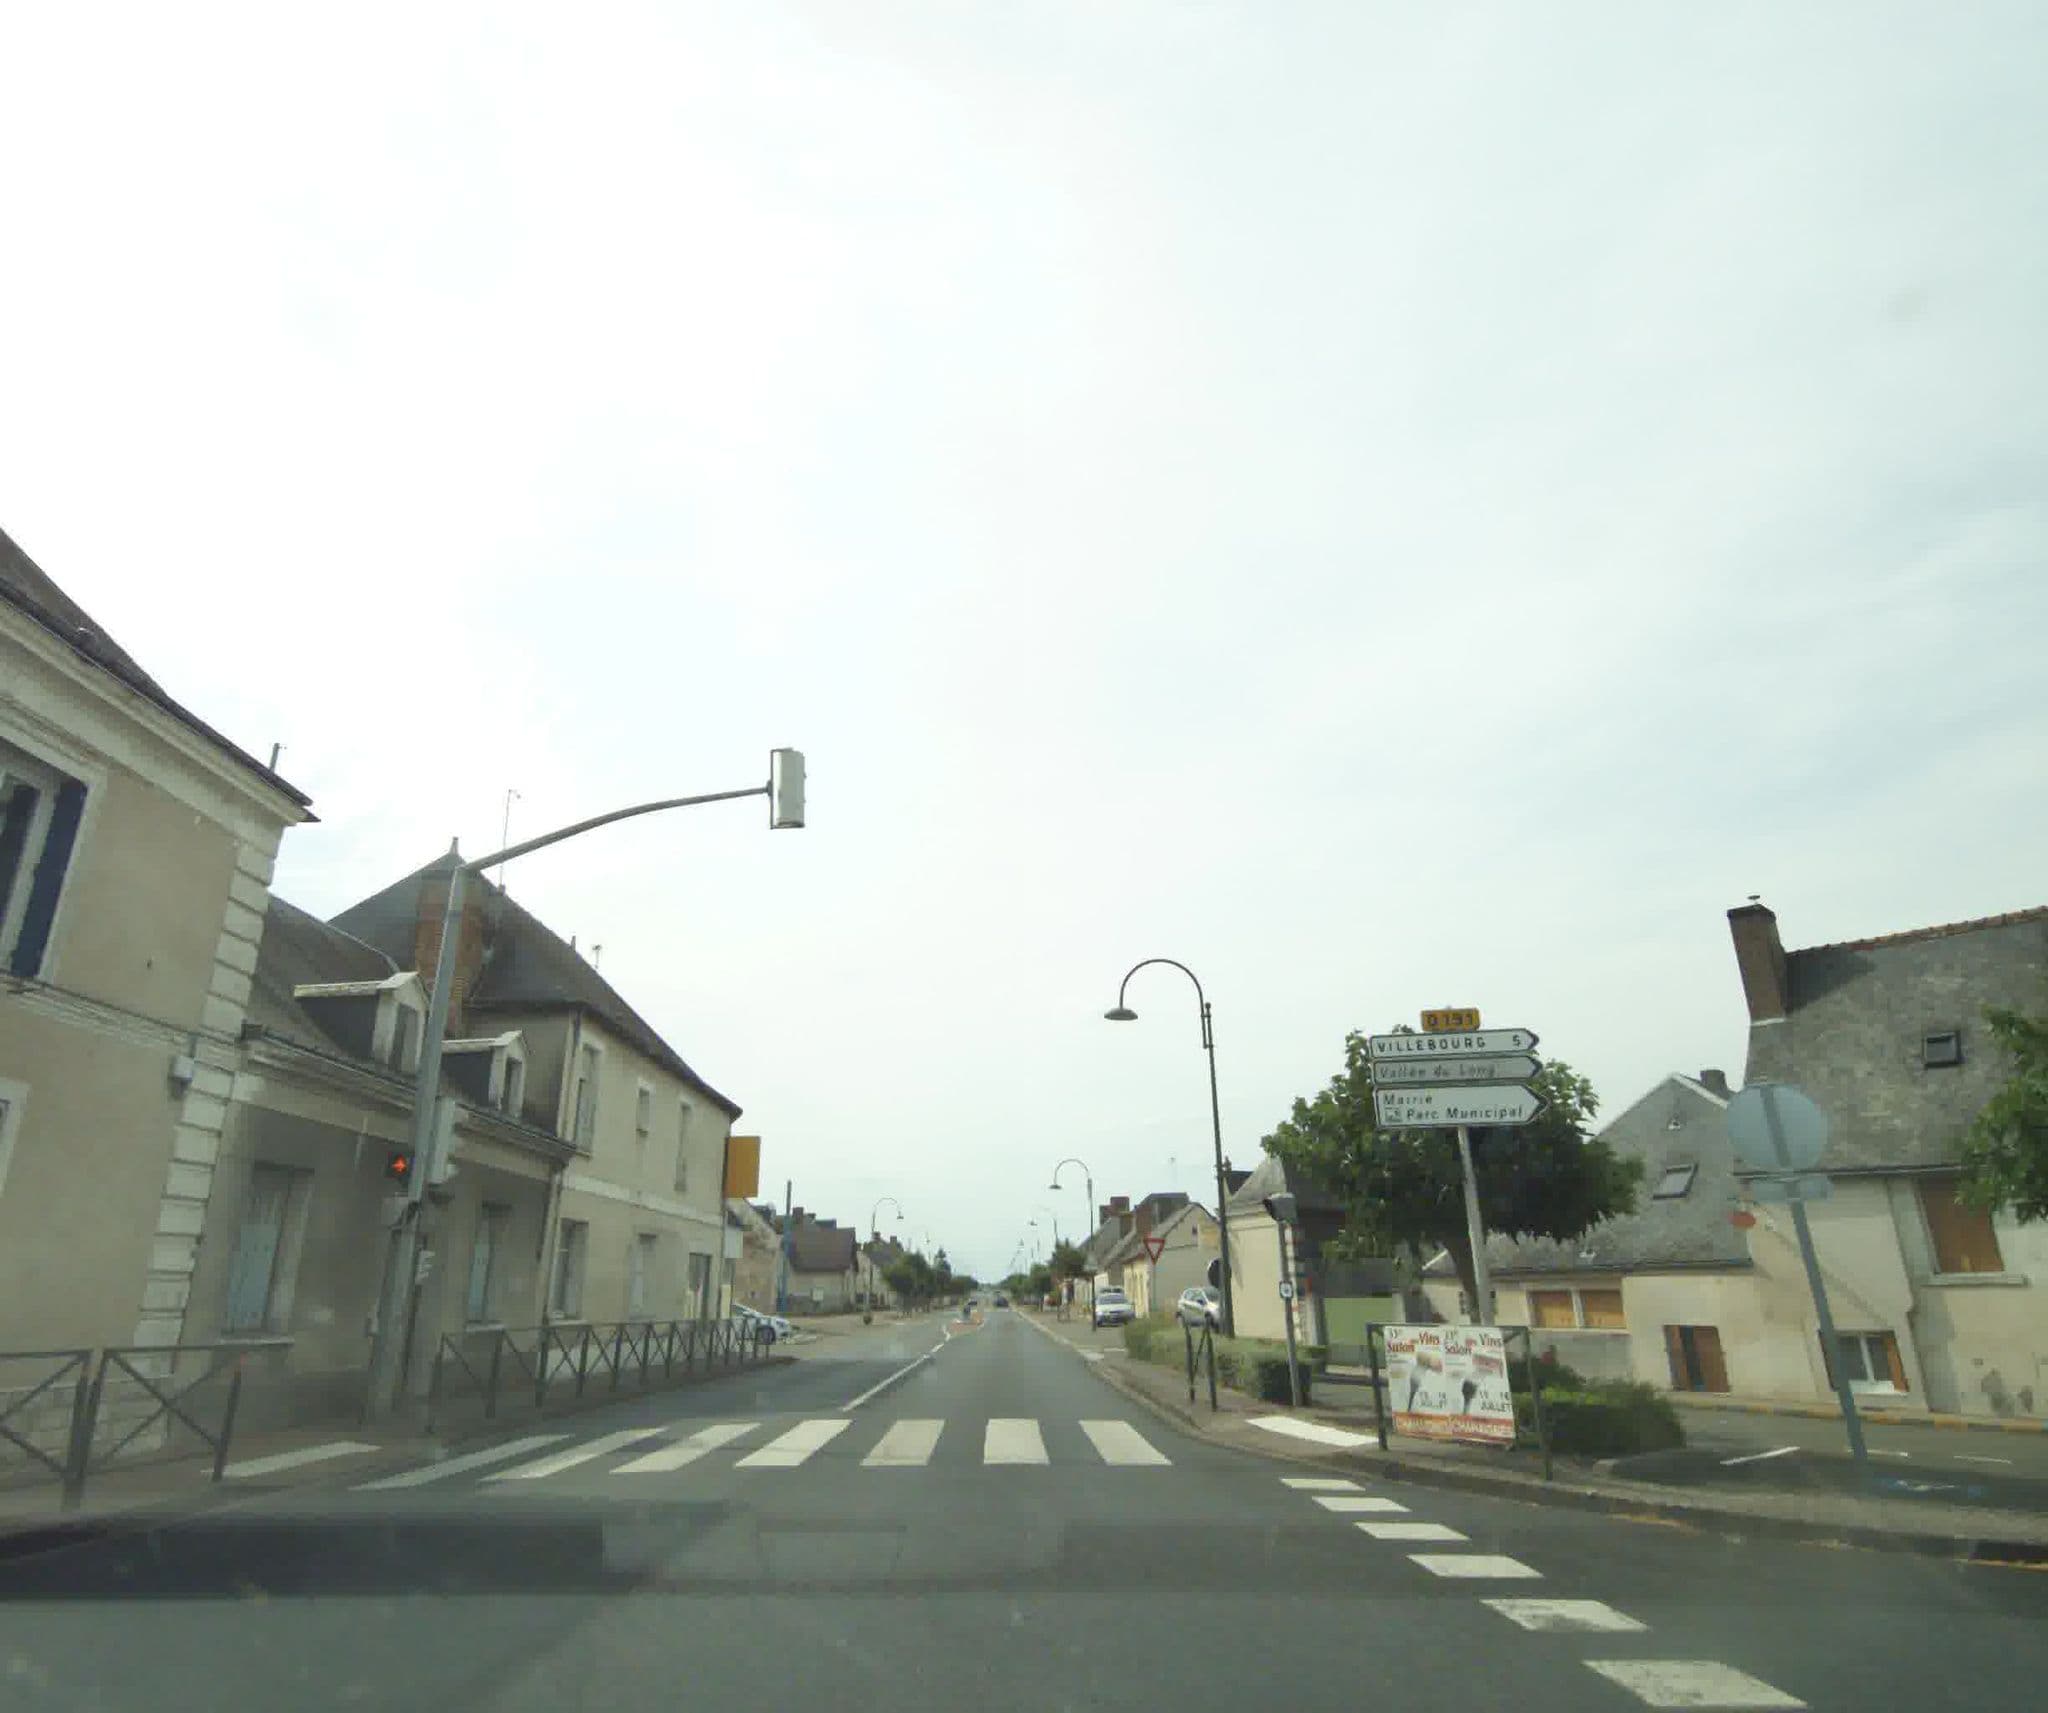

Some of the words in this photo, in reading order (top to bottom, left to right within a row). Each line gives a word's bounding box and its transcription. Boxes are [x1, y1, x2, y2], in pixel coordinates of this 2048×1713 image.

[1376, 1035, 1486, 1053] VILLEBOURG
[1383, 1093, 1433, 1106] Mairie
[1406, 1108, 1440, 1120] Parc
[1447, 1104, 1524, 1120] Municipal
